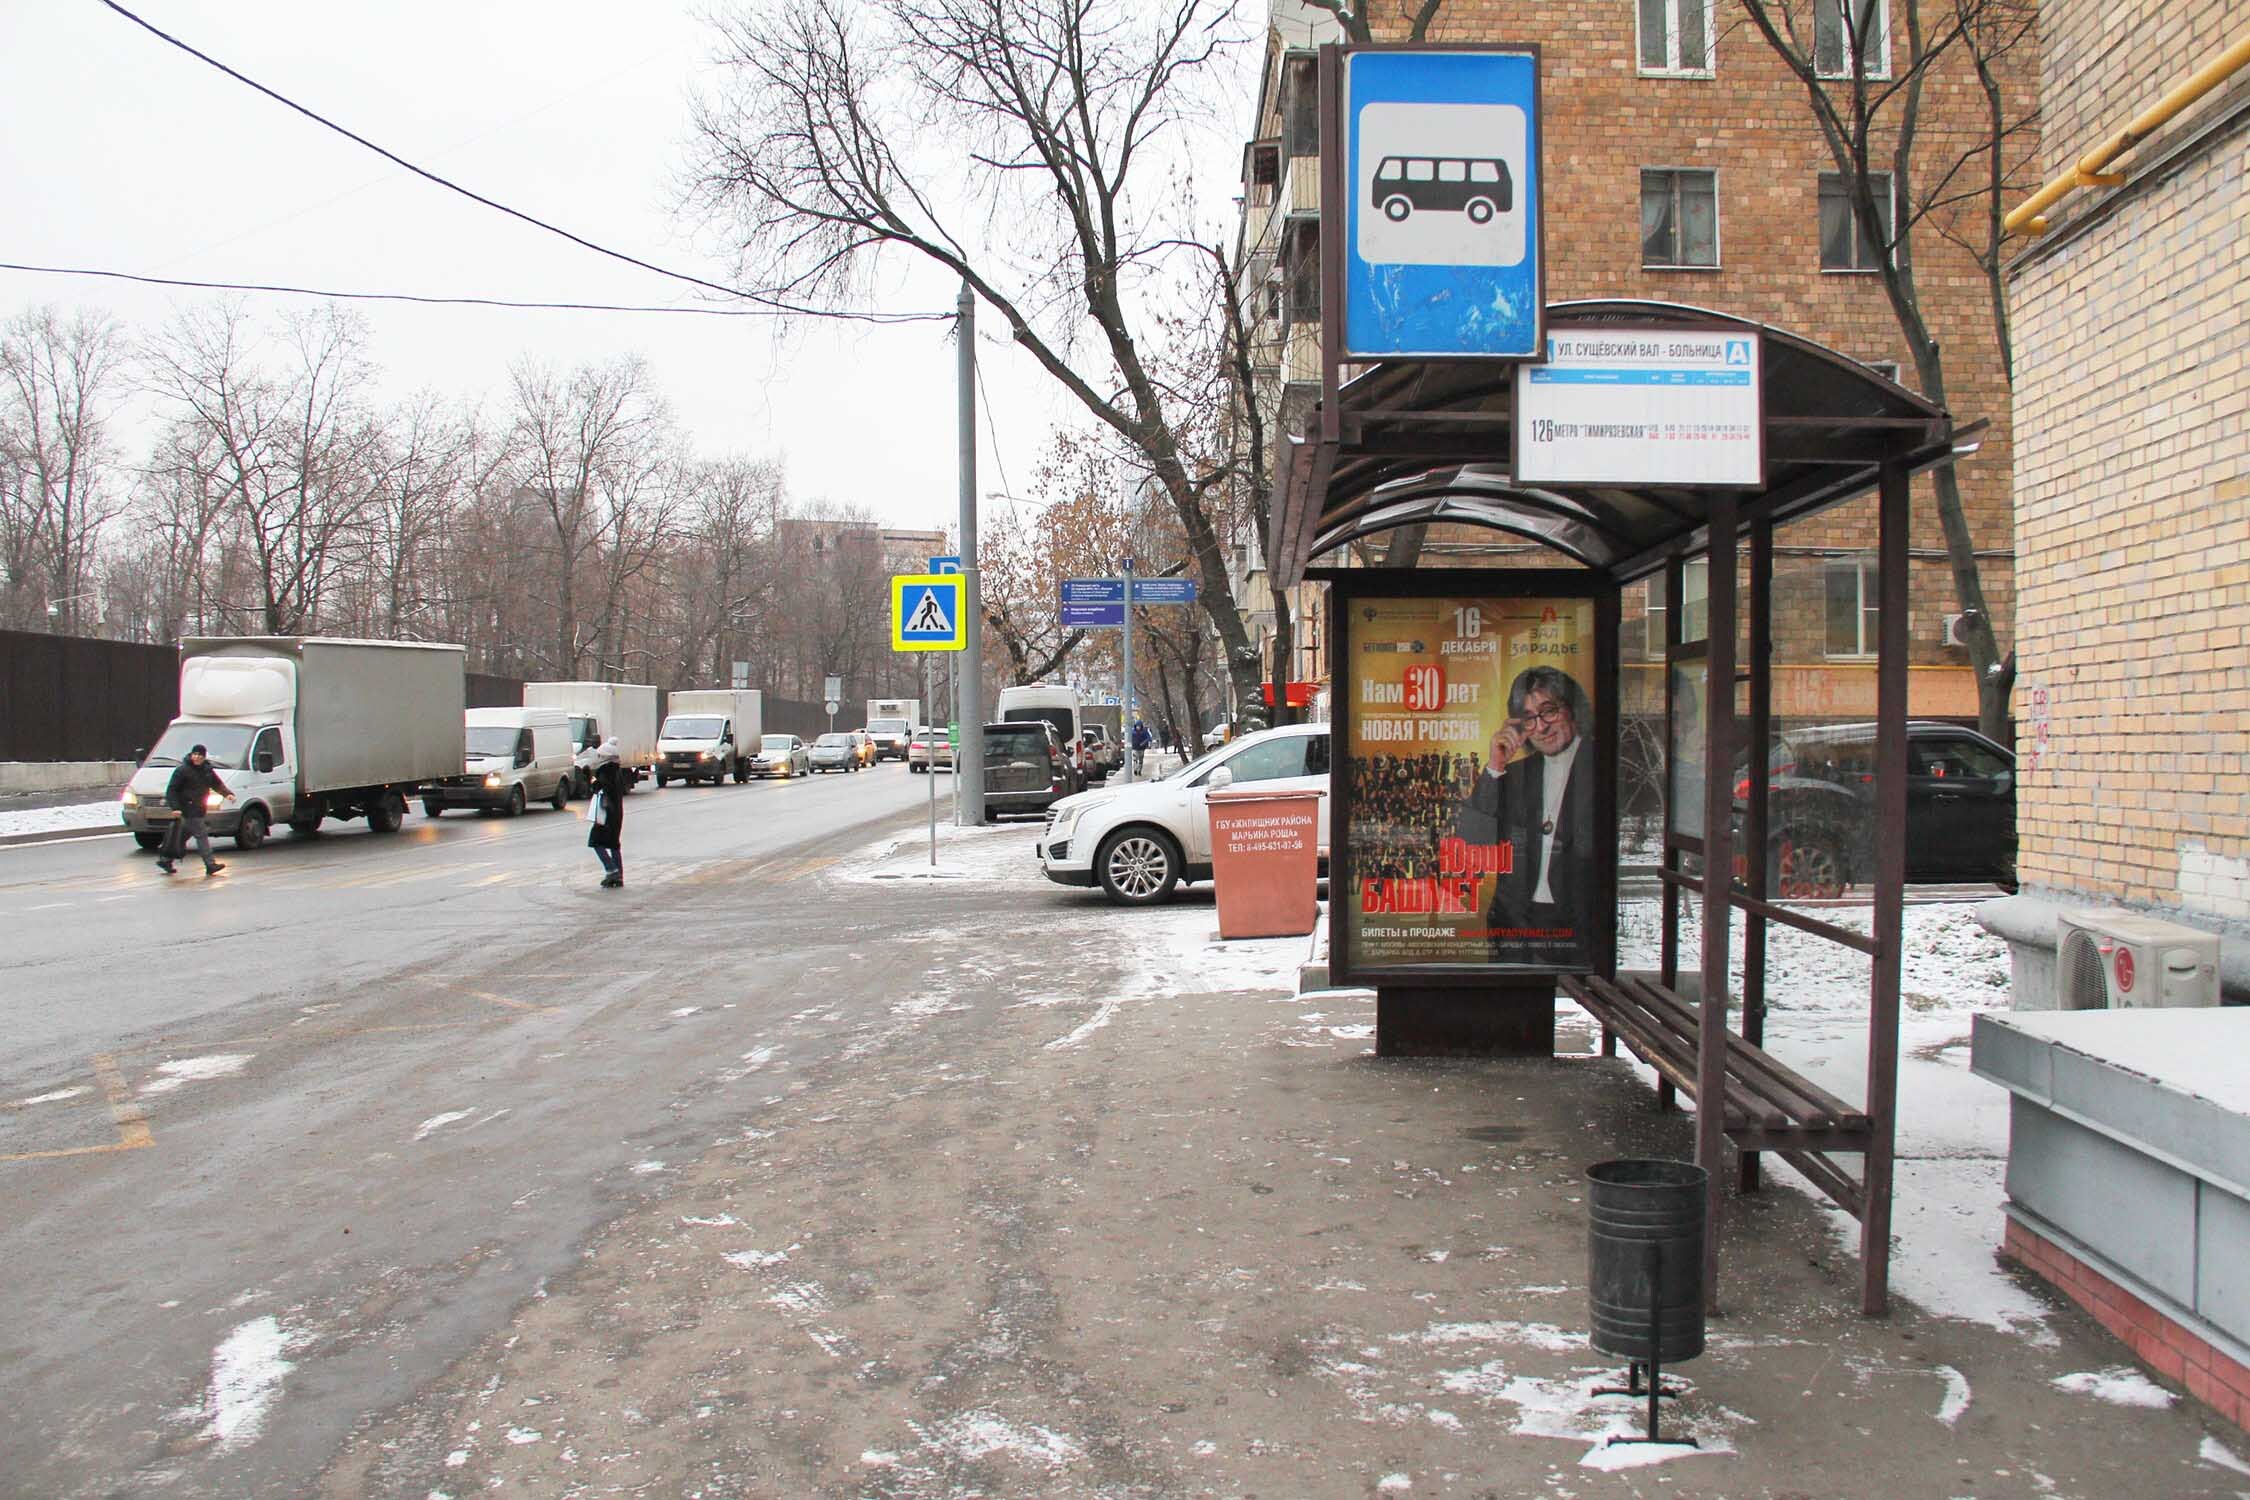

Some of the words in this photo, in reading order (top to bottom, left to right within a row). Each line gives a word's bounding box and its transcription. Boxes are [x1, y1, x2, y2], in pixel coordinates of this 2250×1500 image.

[1558, 343, 1573, 357] УЛ.
[1639, 344, 1660, 358] ВАЛ
[1669, 345, 1721, 359] БОЛЬНИЦА
[1532, 419, 1553, 442] 126
[1554, 424, 1579, 438] МЕТРО
[1455, 607, 1481, 639] 16
[1530, 628, 1558, 640] ЗАЛ
[1440, 640, 1497, 656] ДЕКАБРЯ
[1511, 643, 1579, 657] ЗАРЯДЬЕ
[1362, 680, 1404, 703] Нам
[1408, 668, 1439, 710] 30
[1446, 684, 1480, 703] лет
[1361, 720, 1413, 741] НОВАЯ
[1418, 720, 1480, 741] РОССИЯ
[1216, 820, 1230, 829] ГБУ
[1281, 815, 1312, 826] РАЙОНА
[1440, 838, 1513, 880] Юрий
[1362, 879, 1482, 914] БАШМЕТ
[1361, 927, 1400, 938] БИЛЕТЫ
[1410, 927, 1455, 938] ПРОДАЖЕ
